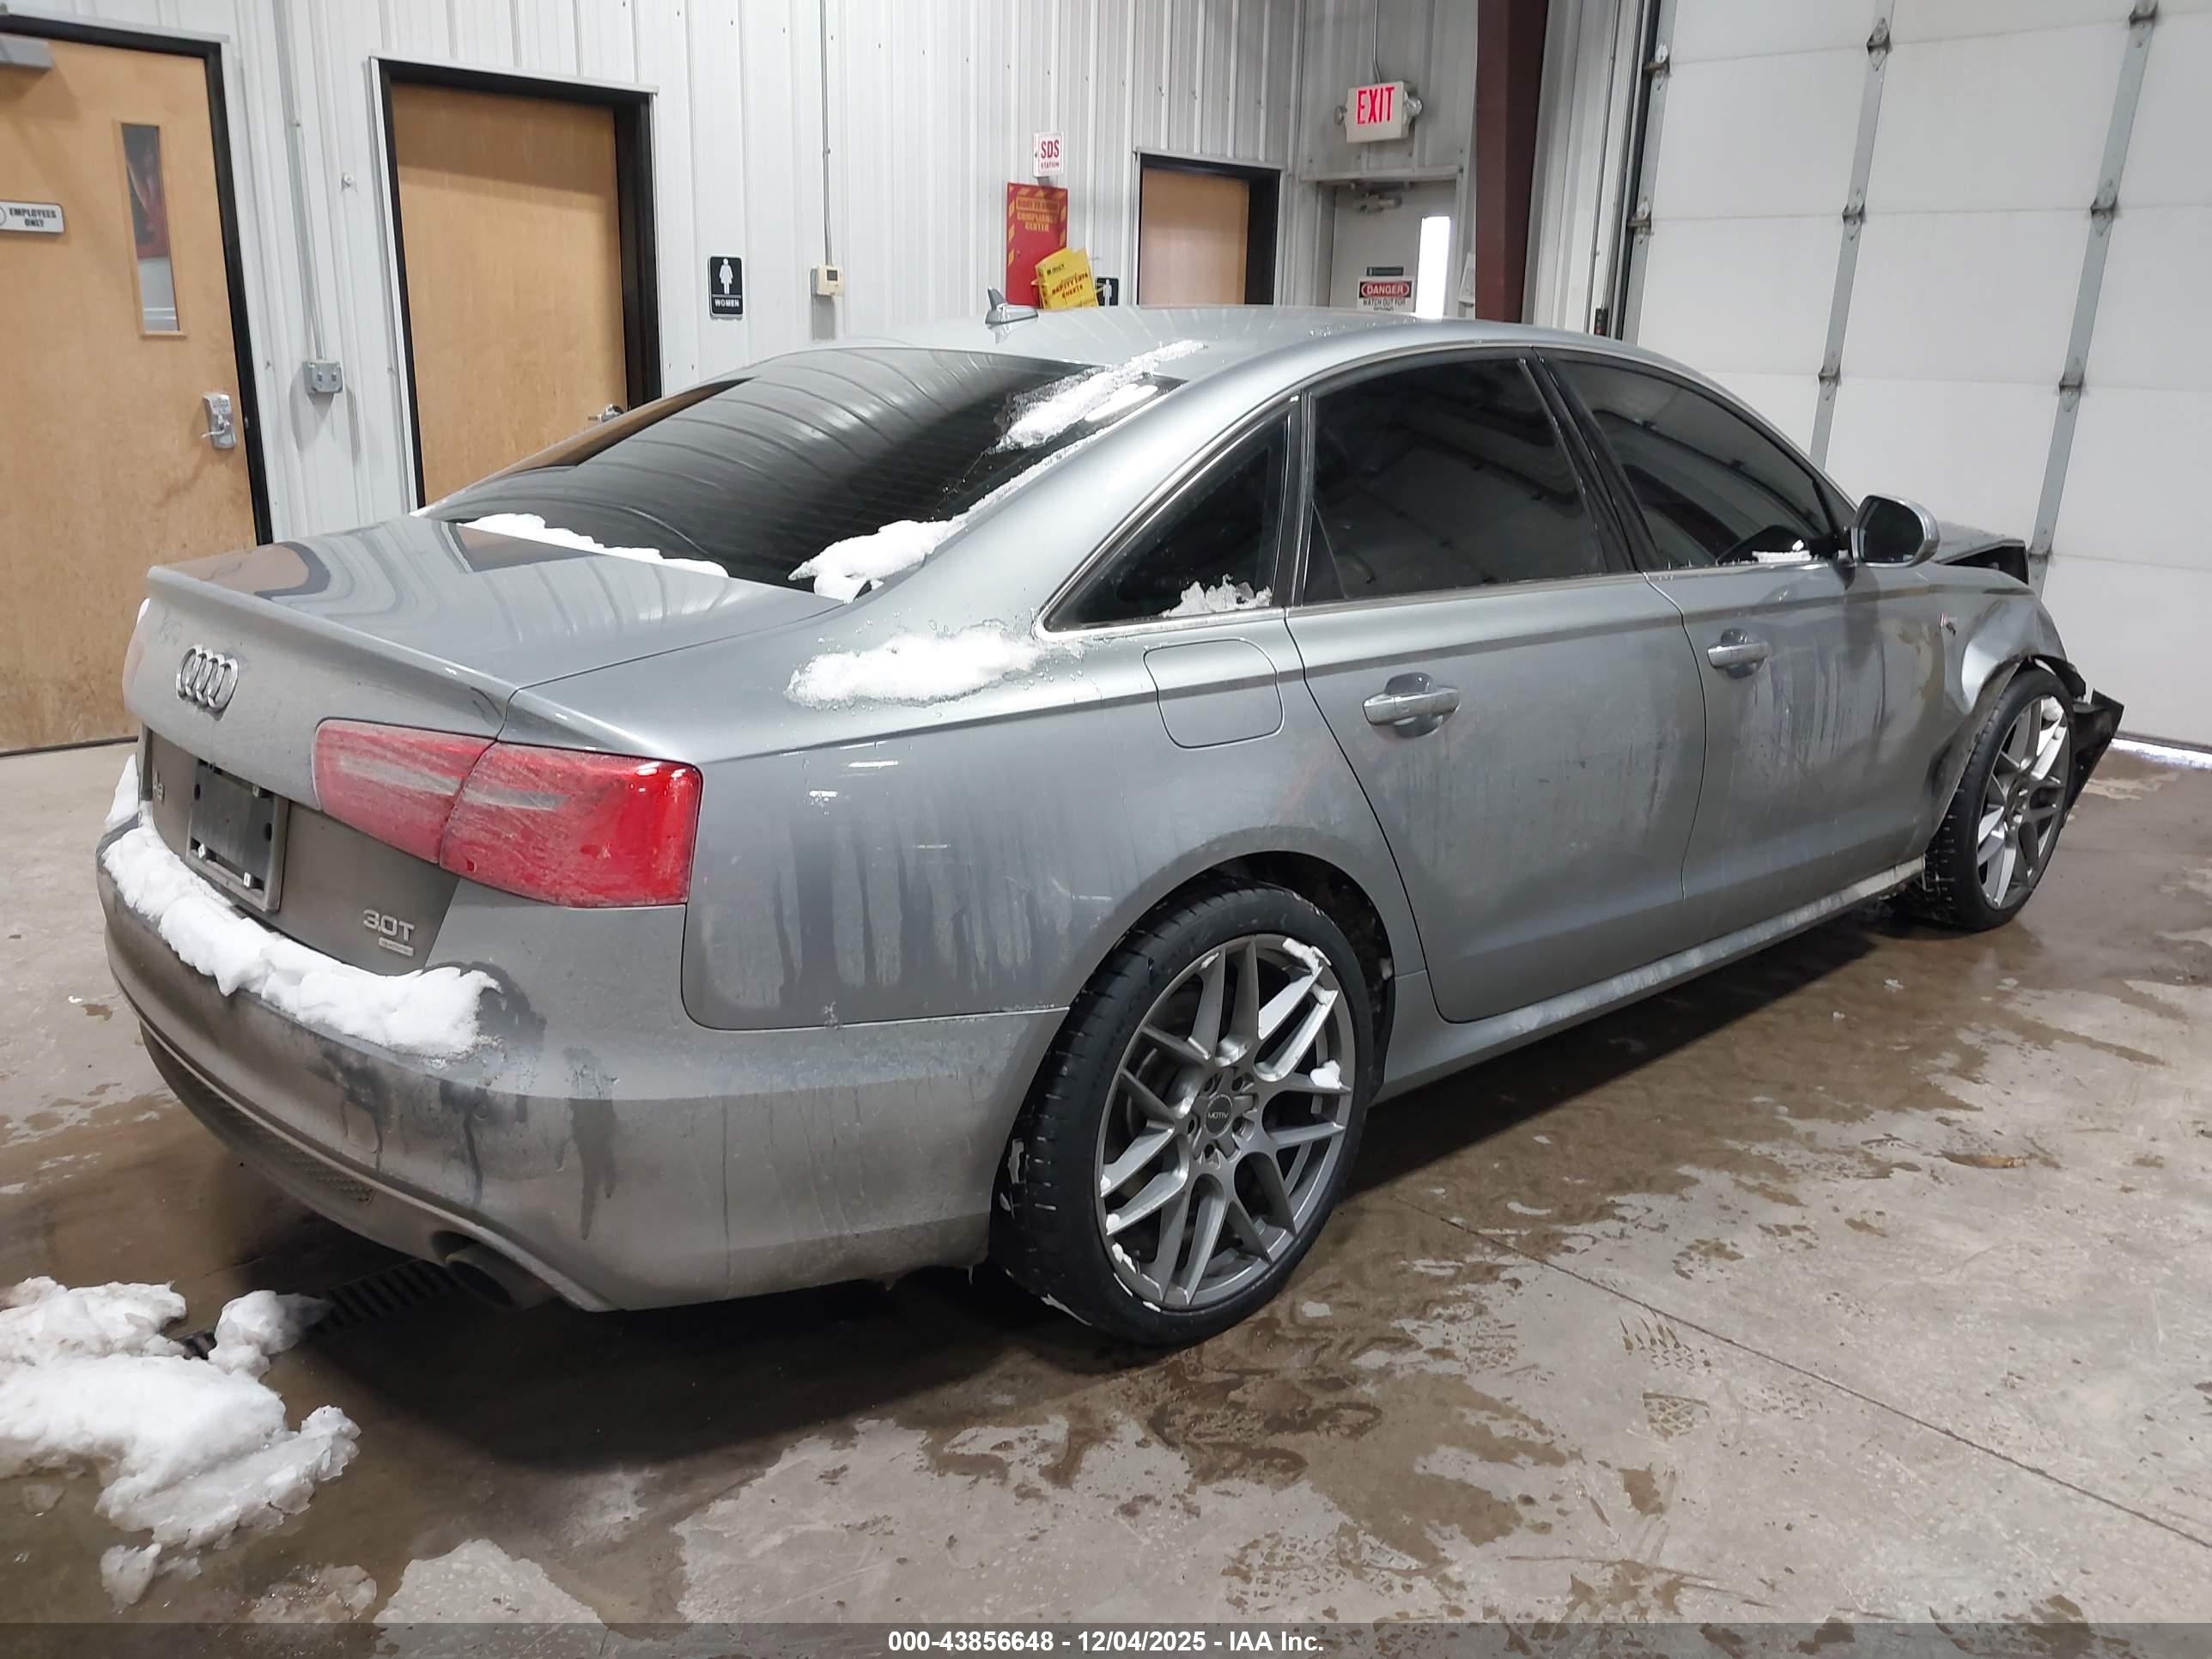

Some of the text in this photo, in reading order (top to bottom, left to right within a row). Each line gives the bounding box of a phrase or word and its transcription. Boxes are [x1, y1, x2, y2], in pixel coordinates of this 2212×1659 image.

[1358, 87, 1395, 125] EXIT
[1041, 139, 1060, 159] SDS
[9, 207, 57, 218] EMPLOYEES
[24, 218, 44, 227] ONLY
[1366, 284, 1404, 295] DANGER
[714, 299, 739, 307] WOMEN
